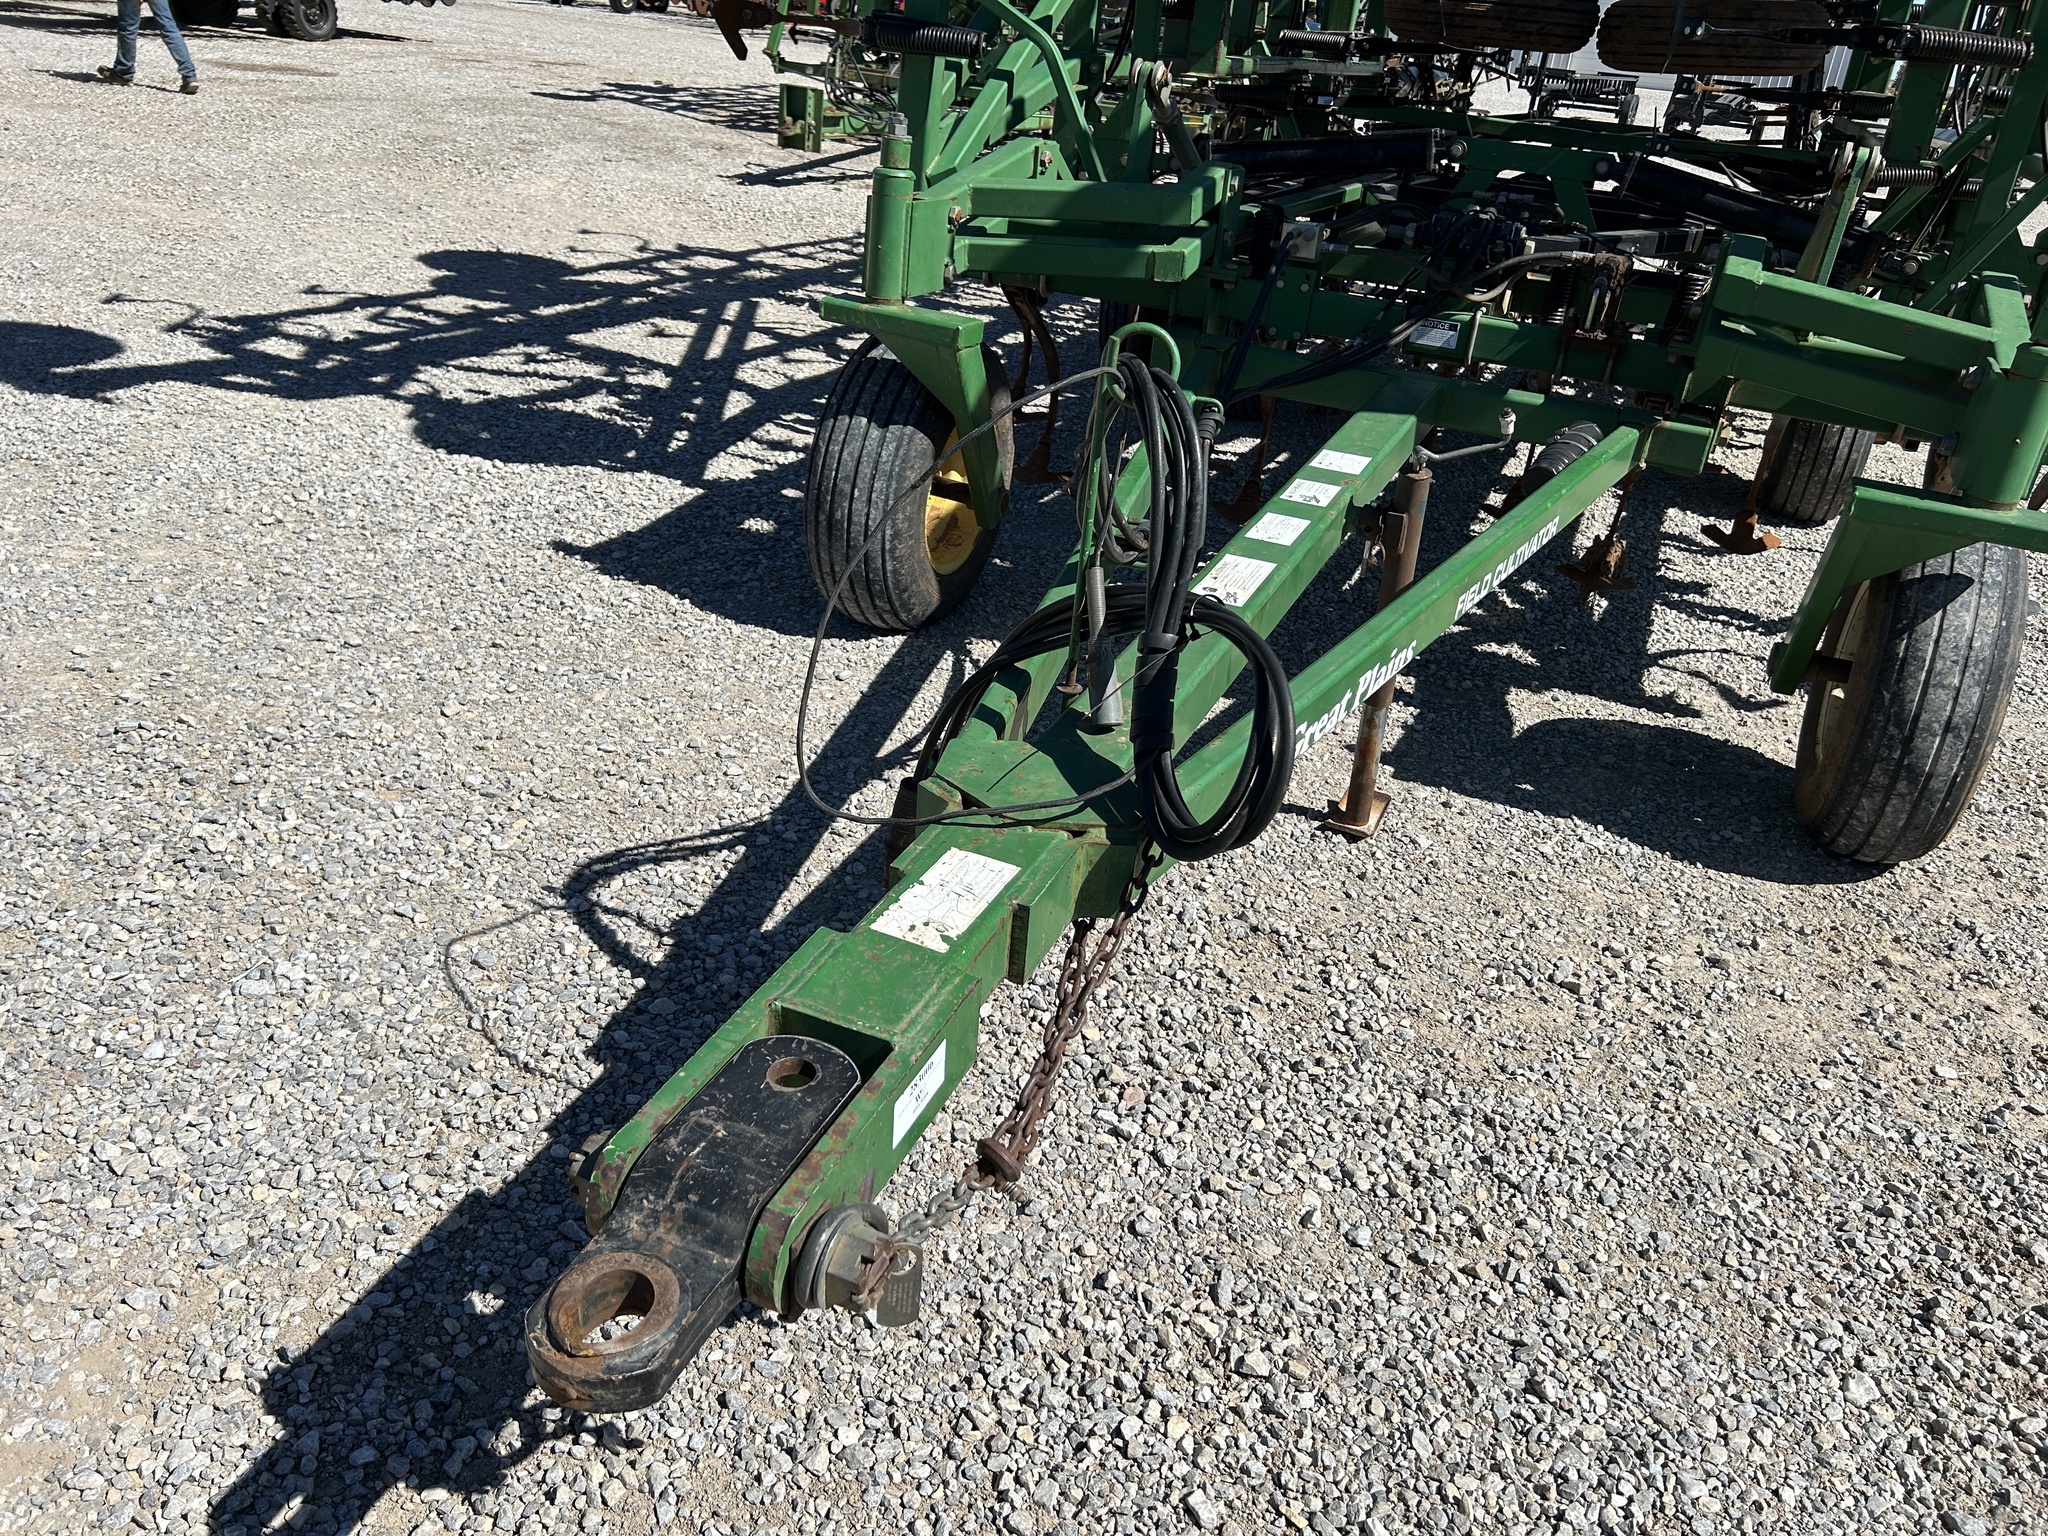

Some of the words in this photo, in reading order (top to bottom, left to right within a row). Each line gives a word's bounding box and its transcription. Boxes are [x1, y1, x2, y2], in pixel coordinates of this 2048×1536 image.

[1422, 320, 1450, 330] NOTICE
[1454, 572, 1492, 621] FIELD
[1492, 515, 1560, 588] CULTIVATOR
[1350, 639, 1417, 712] Plains
